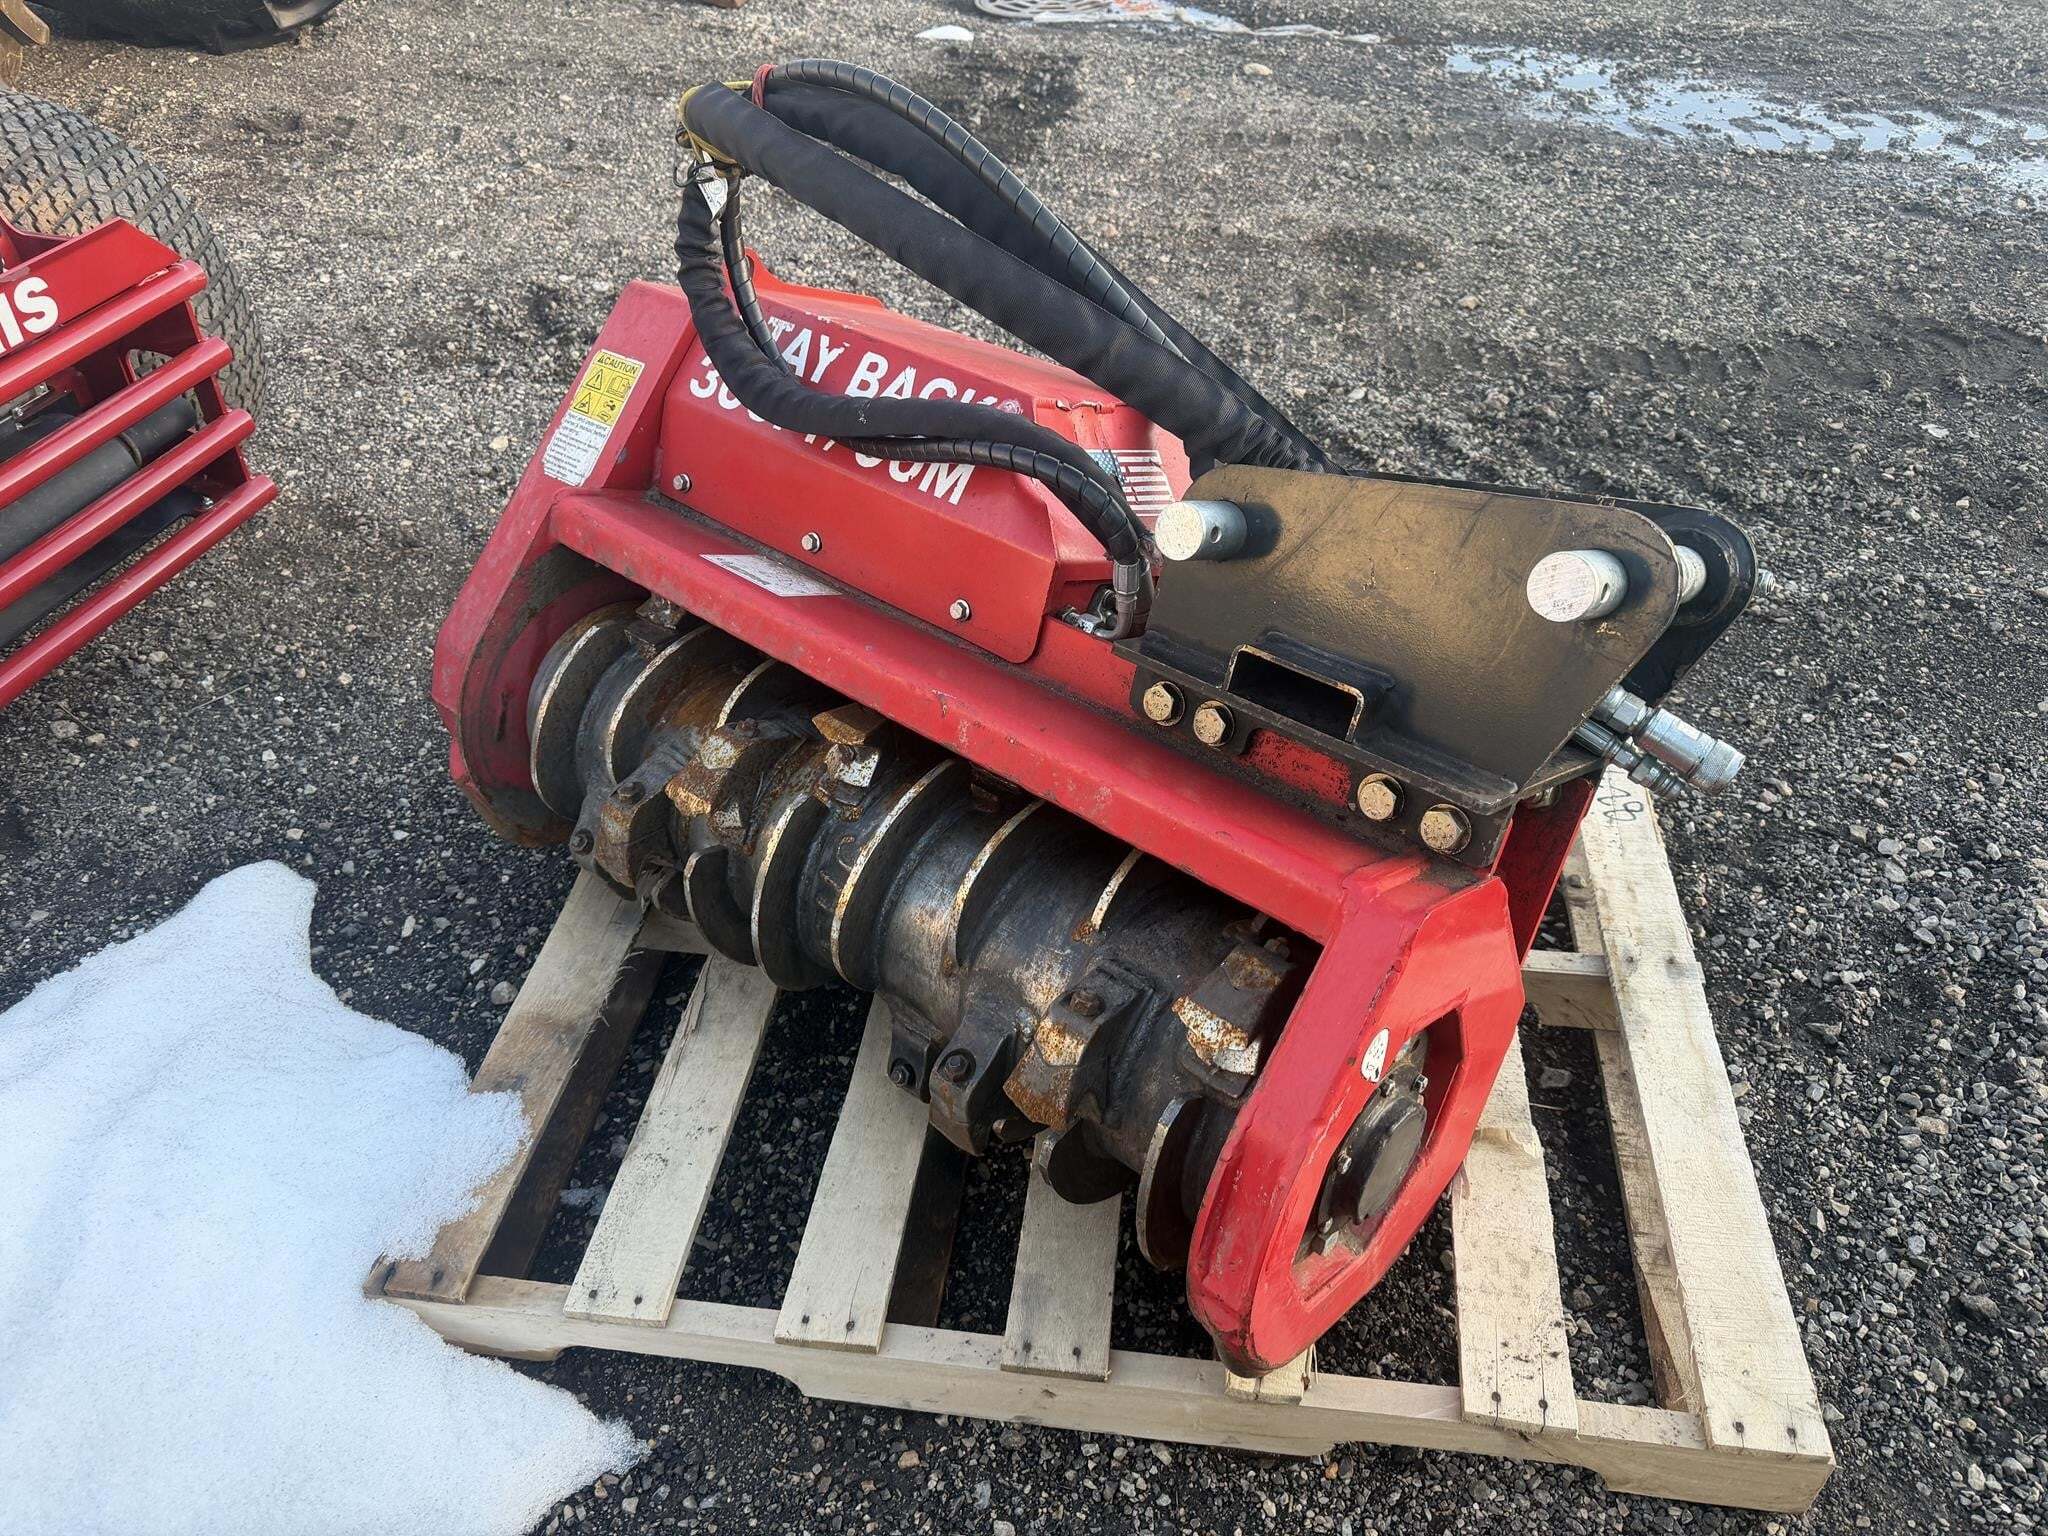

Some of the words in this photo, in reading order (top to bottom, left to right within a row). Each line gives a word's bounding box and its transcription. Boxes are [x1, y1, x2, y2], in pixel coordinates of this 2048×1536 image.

[0, 276, 59, 354] IS
[766, 315, 850, 384] TAY
[604, 356, 638, 375] CAUTION
